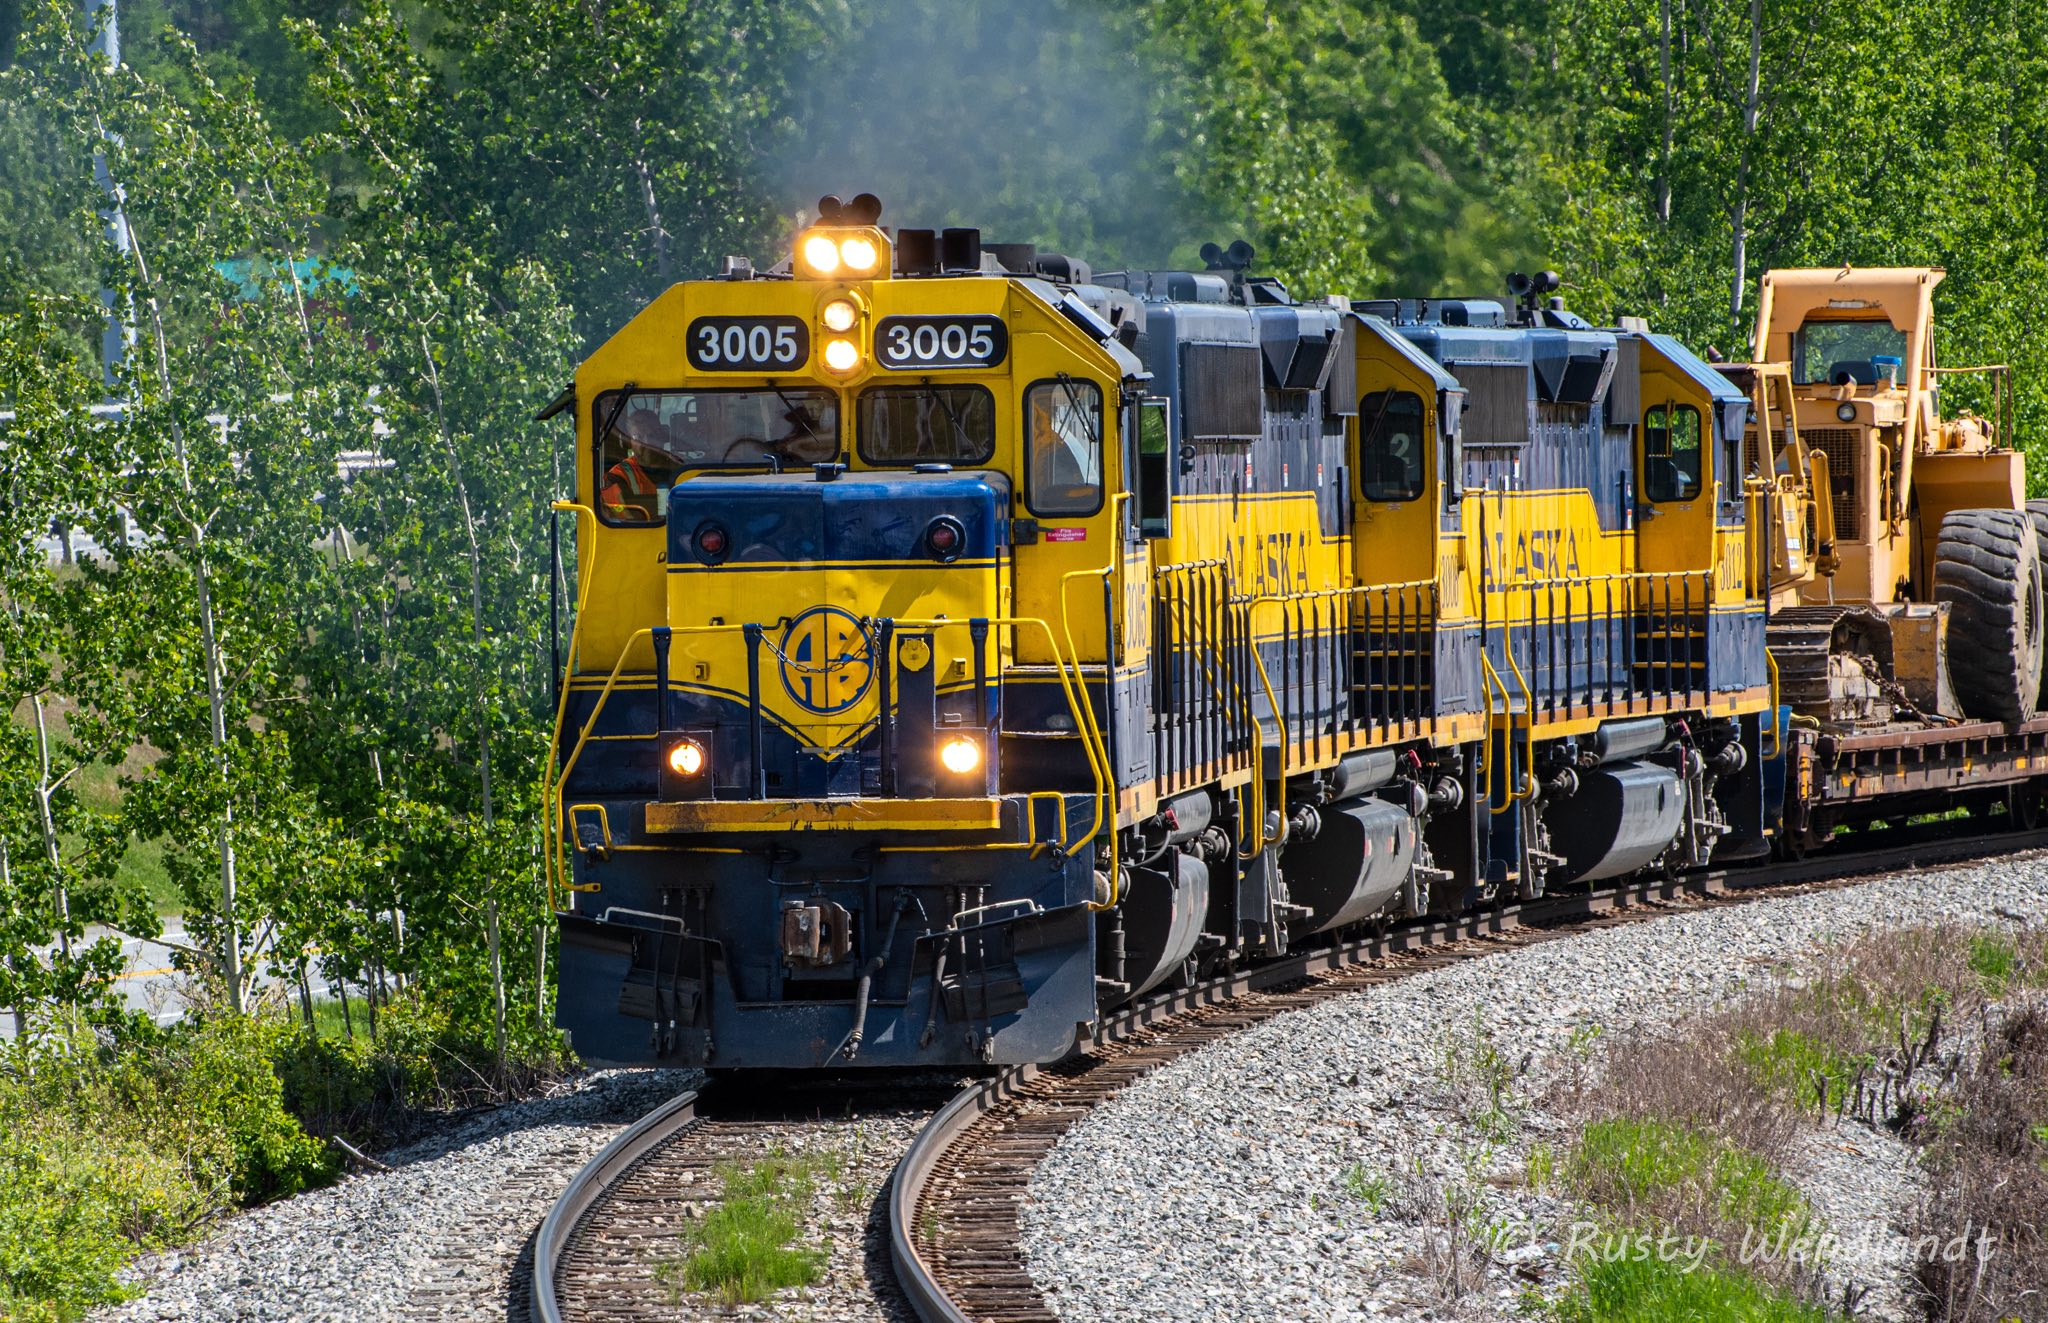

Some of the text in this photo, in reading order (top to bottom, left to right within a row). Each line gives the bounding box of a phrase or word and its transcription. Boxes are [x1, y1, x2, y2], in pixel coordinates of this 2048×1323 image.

[698, 326, 797, 363] 3005
[887, 325, 993, 360] 3005
[1223, 531, 1310, 602] ALASKA
[1478, 526, 1582, 592] ALASKA
